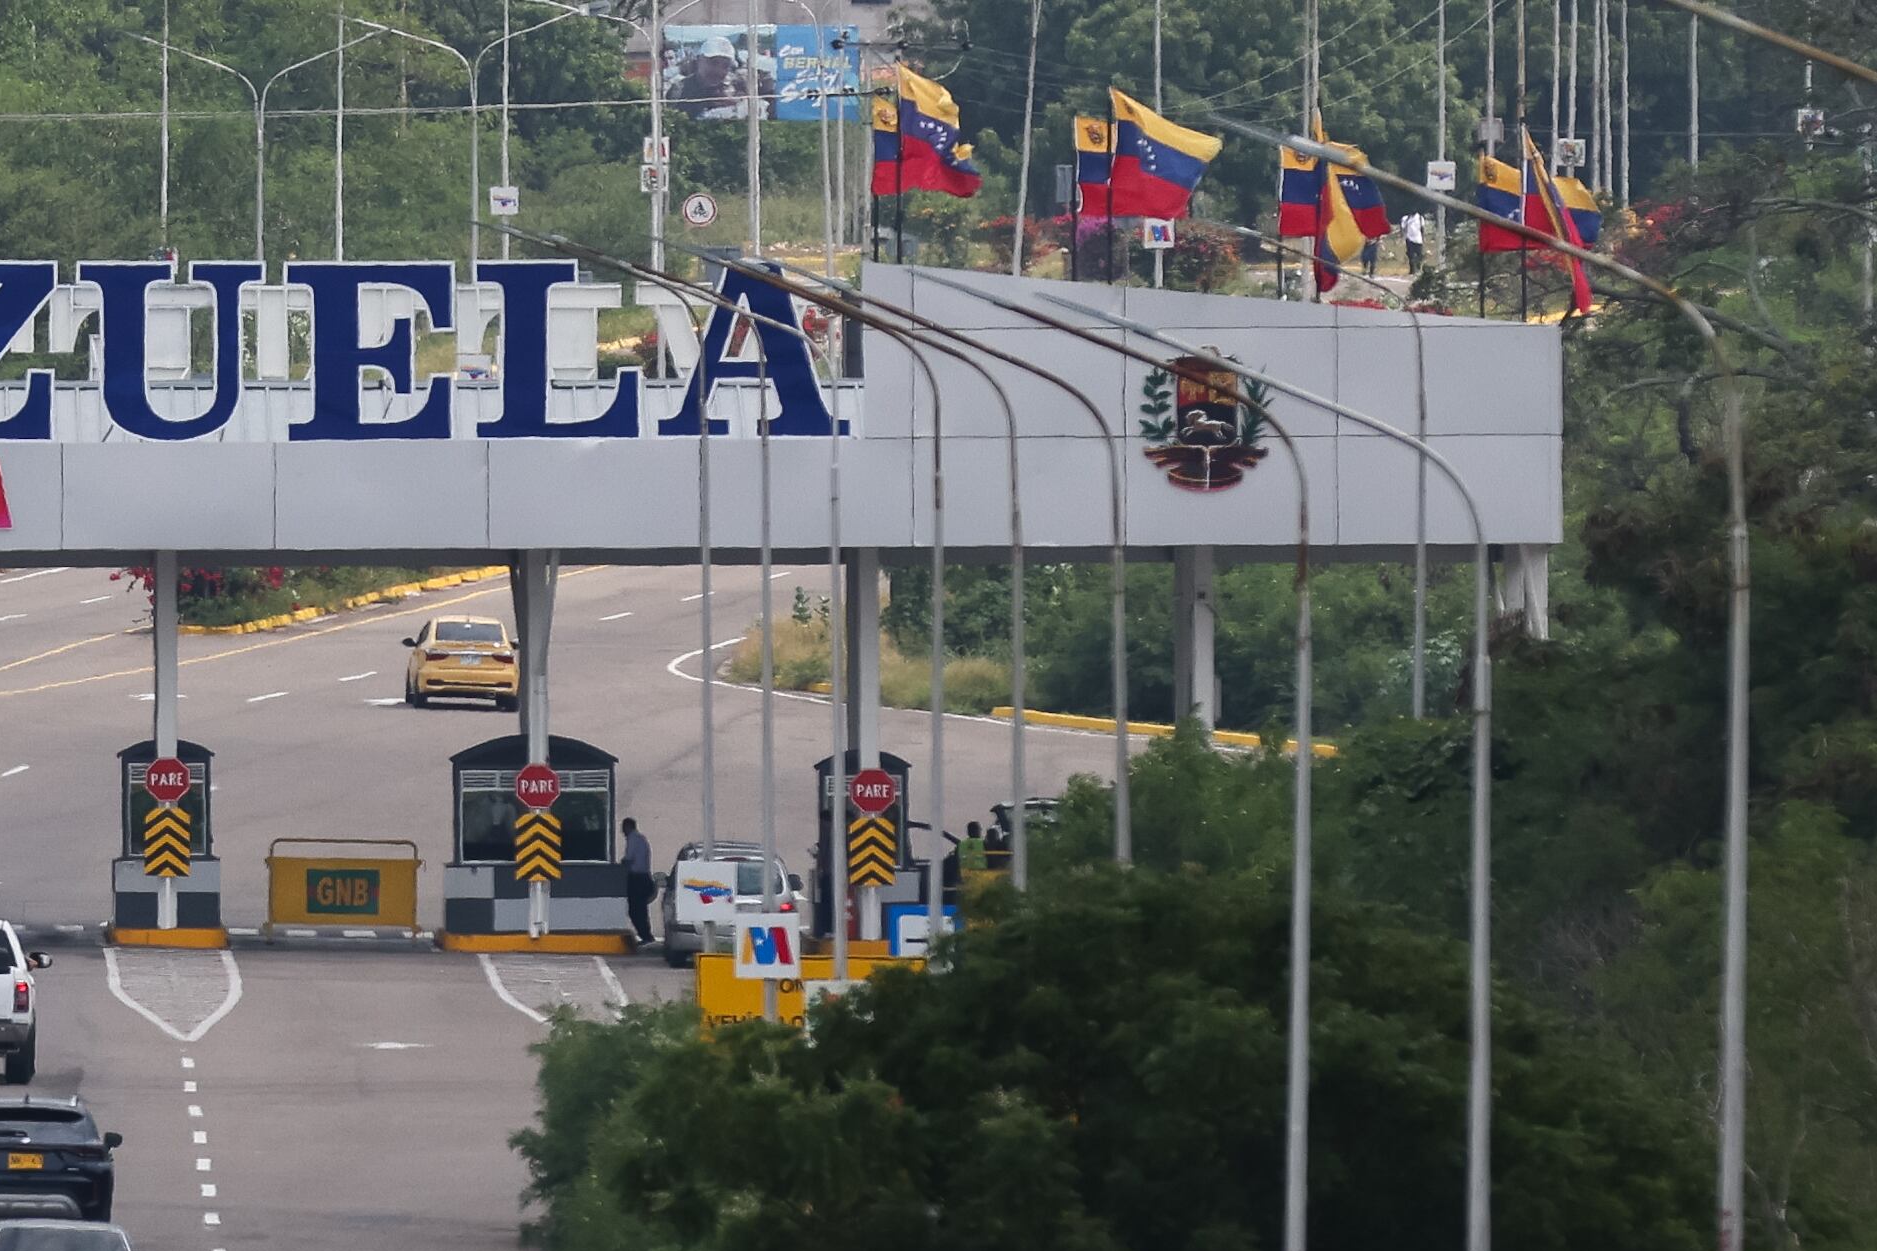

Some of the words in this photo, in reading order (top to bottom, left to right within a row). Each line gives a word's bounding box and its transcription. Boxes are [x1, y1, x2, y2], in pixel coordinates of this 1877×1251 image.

[150, 772, 184, 787] PARE
[520, 779, 555, 794] PARE
[856, 784, 891, 798] PARE
[316, 876, 370, 907] GNB
